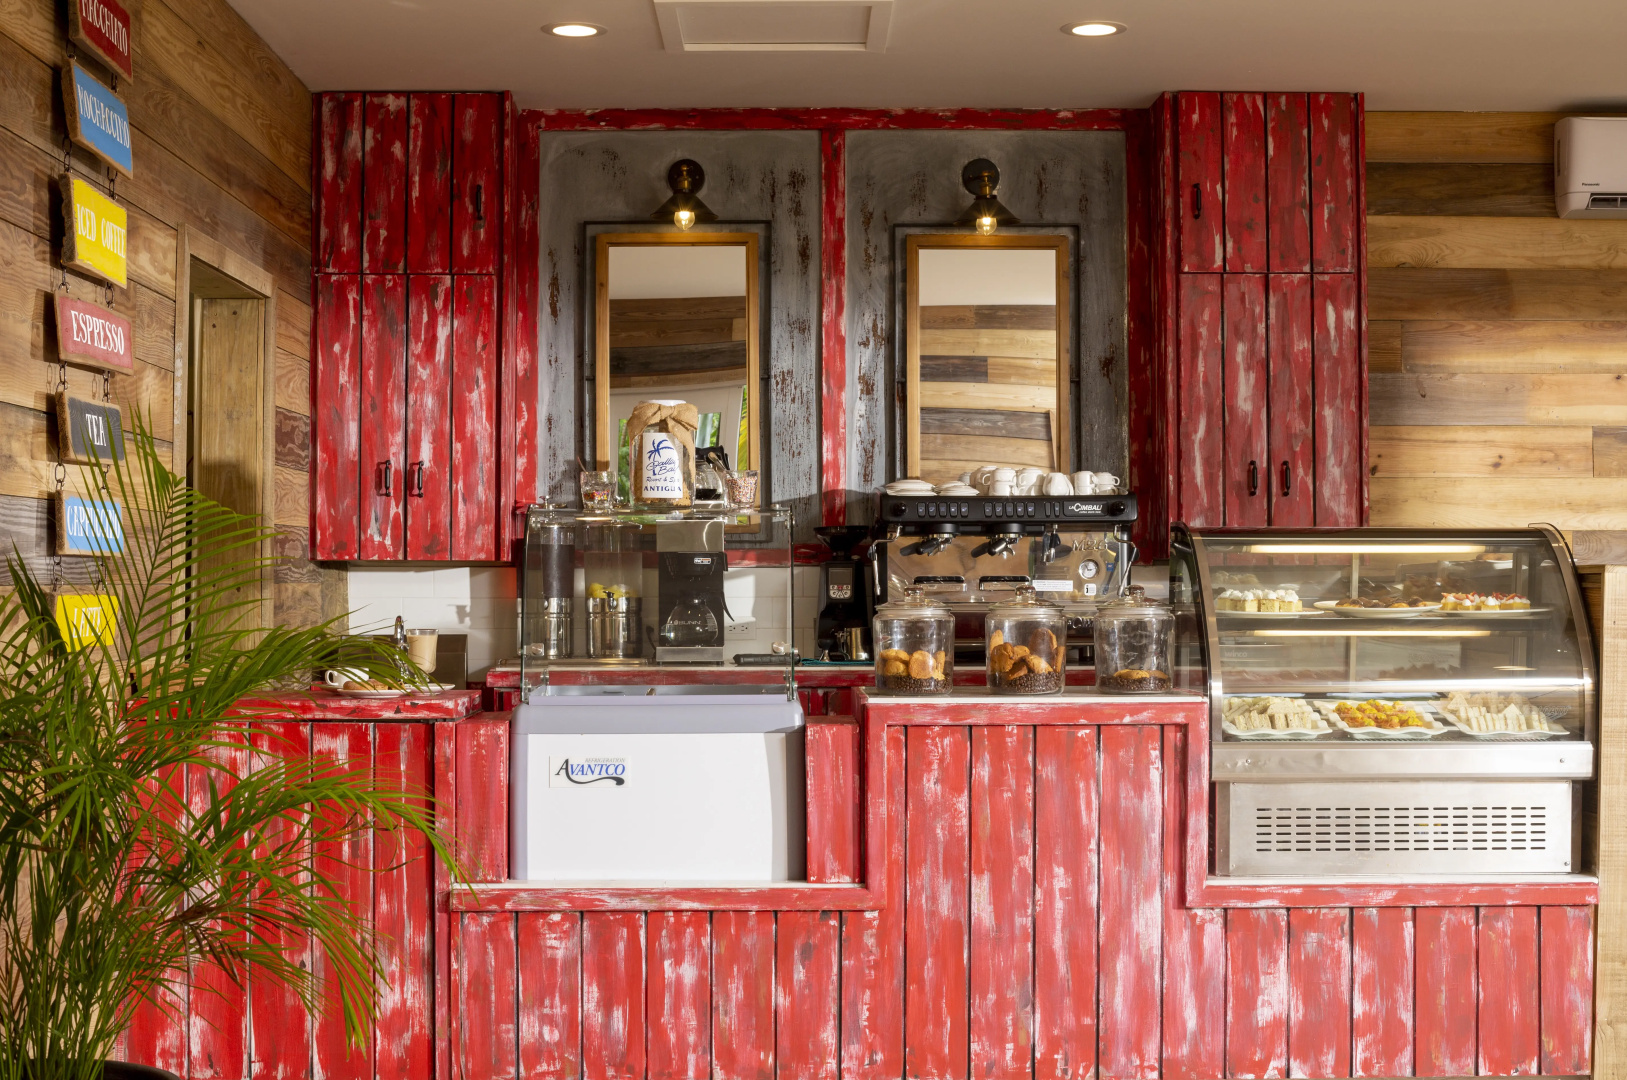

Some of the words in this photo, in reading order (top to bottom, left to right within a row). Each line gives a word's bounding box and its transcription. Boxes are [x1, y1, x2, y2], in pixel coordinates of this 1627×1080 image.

[77, 83, 130, 149] MOCHACCINO
[76, 203, 97, 242] ICED
[101, 217, 126, 259] COFFEE
[70, 310, 125, 356] ESPRESSO
[85, 413, 107, 447] TEA
[66, 505, 121, 540] CAPPUCCINO
[1073, 502, 1103, 512] CIMBALI
[72, 606, 103, 639] LATTE
[554, 757, 626, 784] AVANTCO
